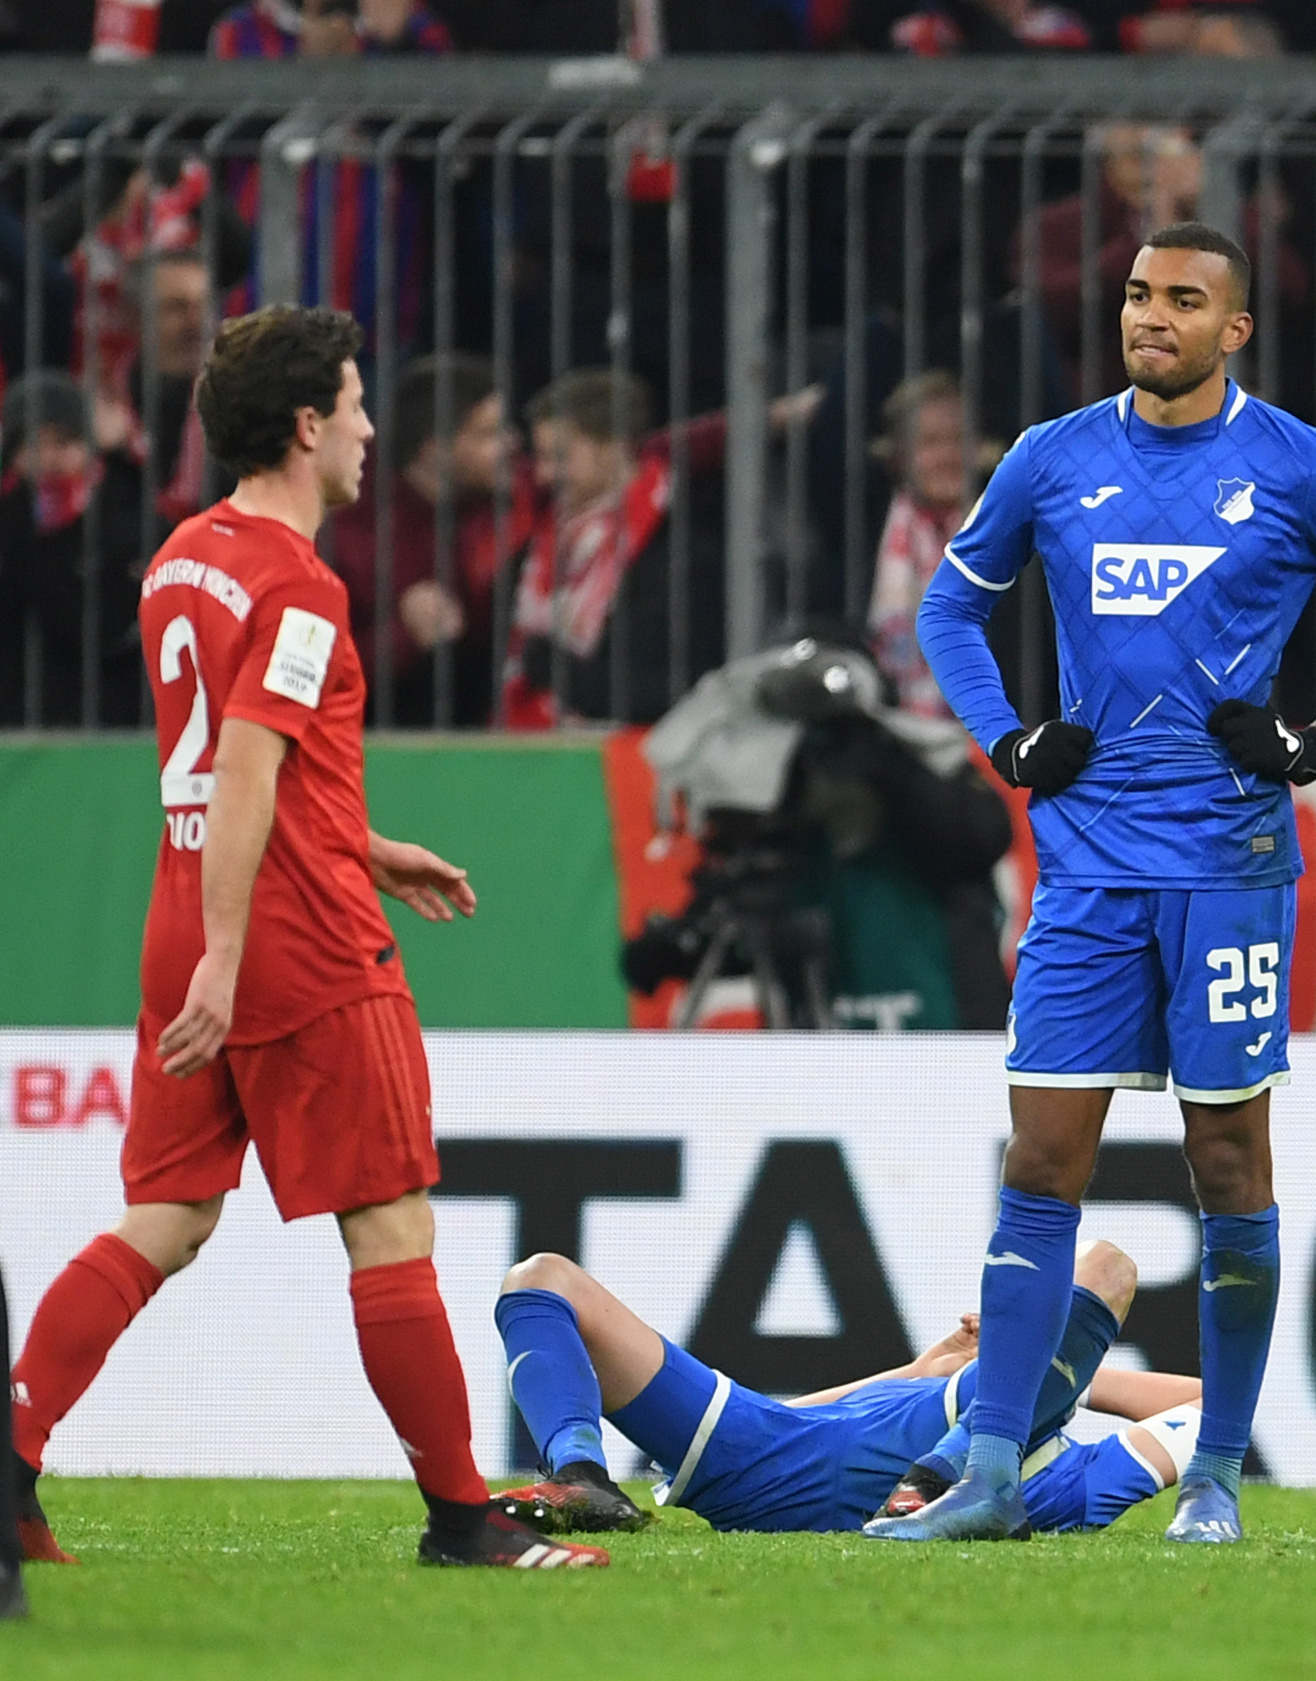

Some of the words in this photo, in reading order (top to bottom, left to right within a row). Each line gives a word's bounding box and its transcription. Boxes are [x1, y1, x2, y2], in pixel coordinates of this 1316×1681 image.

[1095, 556, 1188, 600] SAP
[160, 614, 216, 808] 2
[1206, 942, 1279, 1023] 25
